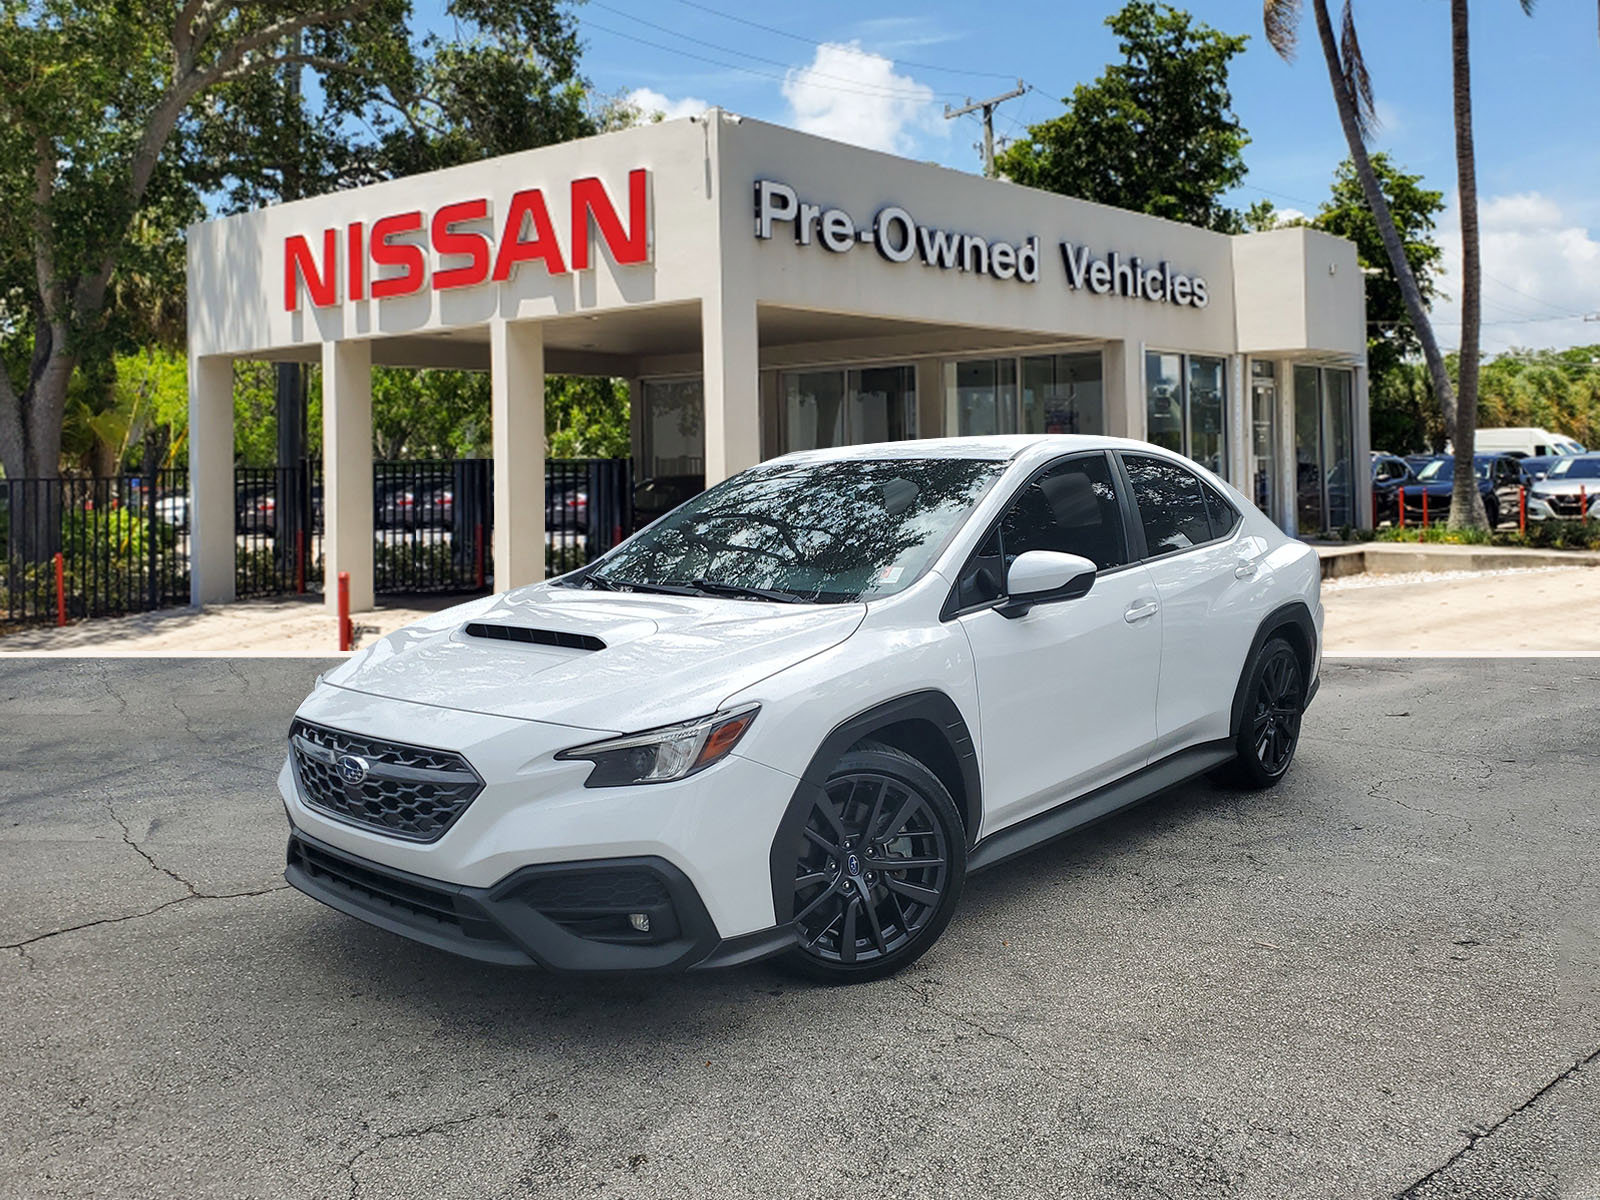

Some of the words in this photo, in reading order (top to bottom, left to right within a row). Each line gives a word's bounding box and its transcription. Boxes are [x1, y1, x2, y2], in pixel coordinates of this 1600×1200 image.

[285, 169, 649, 311] NISSAN
[755, 180, 1040, 284] Pre-Owned
[1060, 241, 1209, 308] Vehicles
